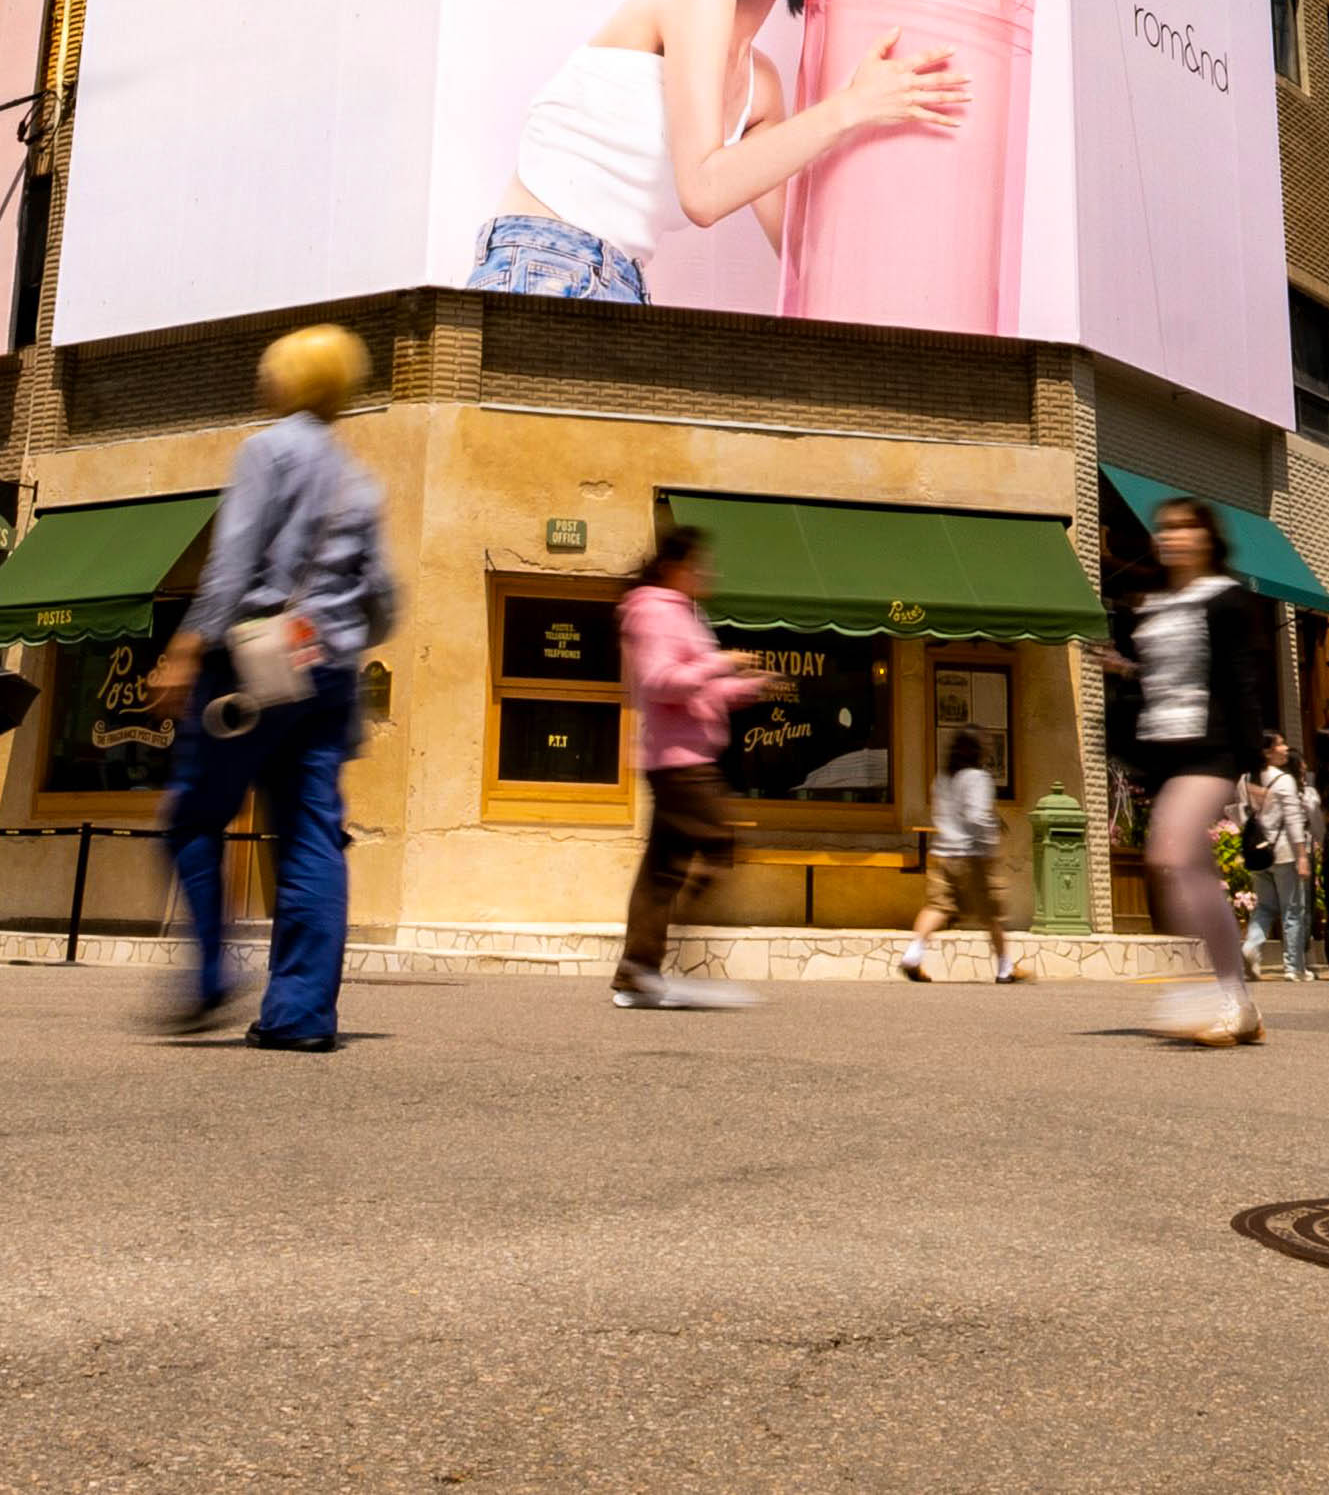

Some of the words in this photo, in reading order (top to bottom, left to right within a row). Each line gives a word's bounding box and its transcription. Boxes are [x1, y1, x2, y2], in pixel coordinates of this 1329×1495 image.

[1133, 3, 1230, 96] rom&nd
[555, 520, 578, 531] POST
[552, 532, 581, 545] OFFICE
[37, 610, 72, 626] POSTES
[743, 722, 813, 752] Parfum
